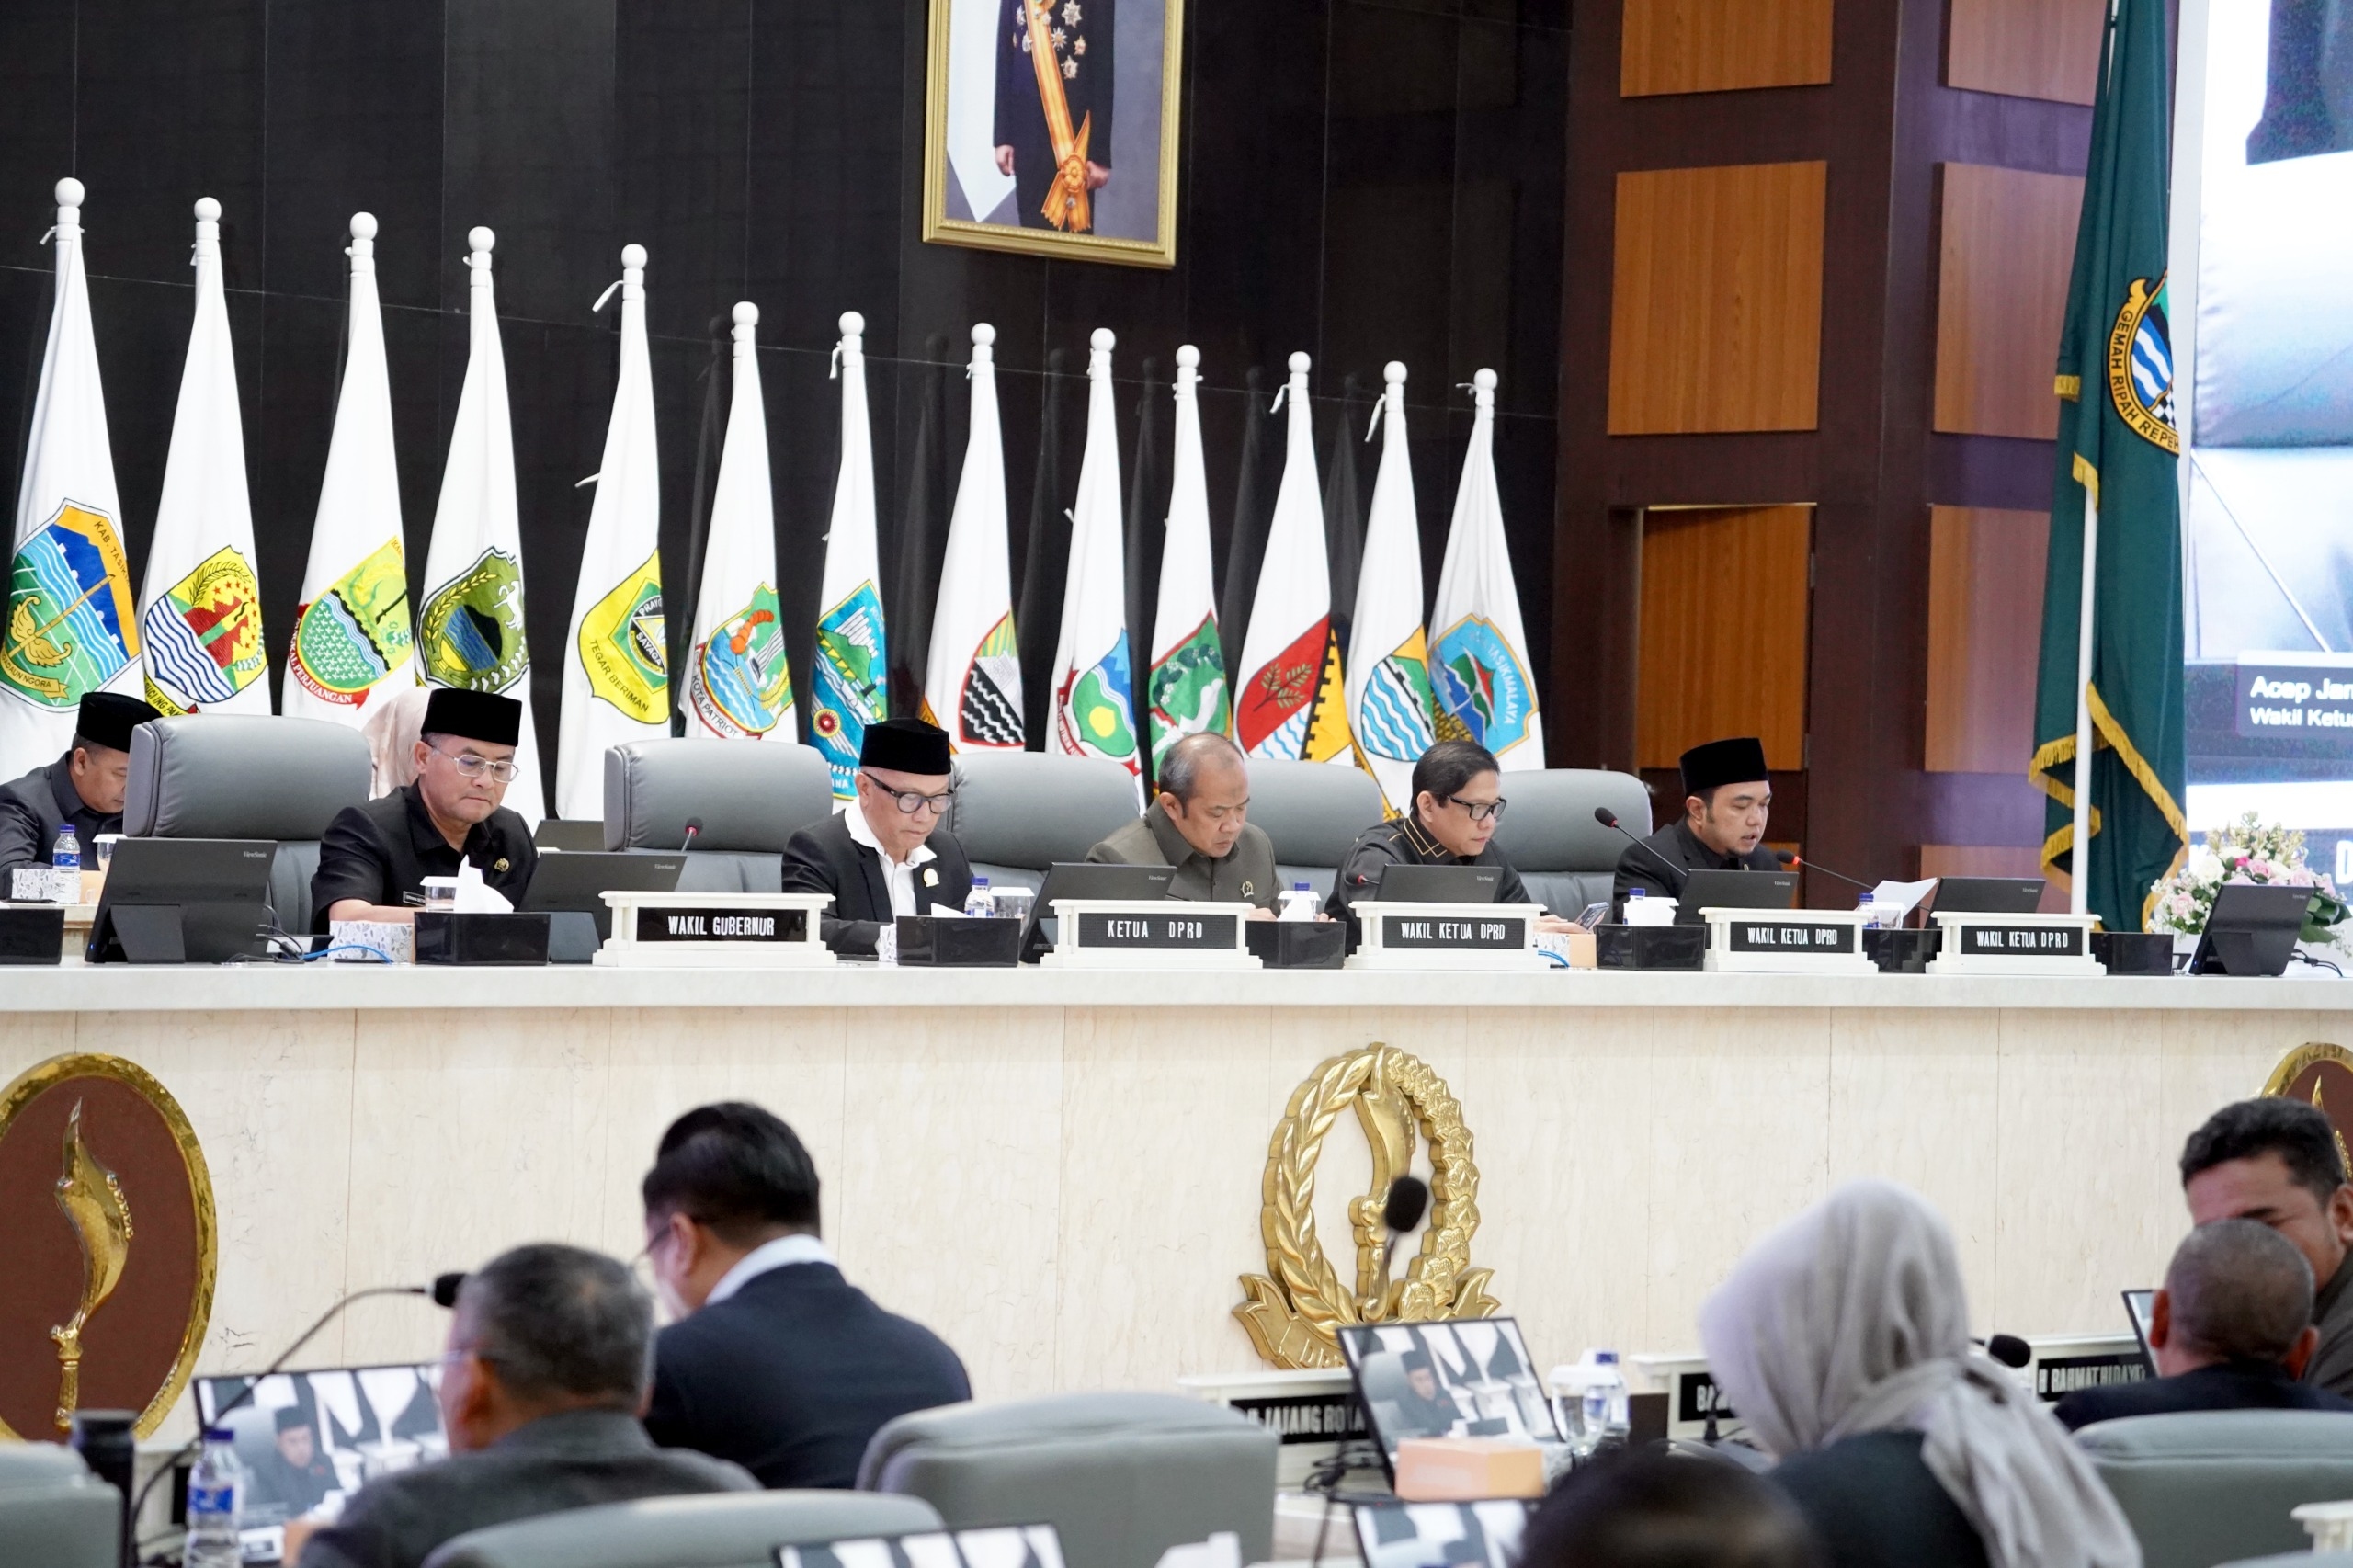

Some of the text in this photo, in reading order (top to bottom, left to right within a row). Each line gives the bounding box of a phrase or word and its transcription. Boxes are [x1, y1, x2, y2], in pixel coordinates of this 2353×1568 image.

[2111, 310, 2133, 369] GEMAH
[2112, 376, 2139, 422] RIPAH
[94, 521, 111, 547] KAB.
[636, 631, 662, 666] SAYAGA
[23, 675, 51, 687] NGORA
[293, 664, 353, 703] PERJUANGAN
[589, 640, 611, 675] TEGAR
[608, 675, 649, 712] BERIMAN
[1488, 645, 1518, 724] TASIKMALAYA
[153, 696, 168, 710] ING
[692, 675, 739, 737] KOTA PATRIOT
[2250, 707, 2302, 726] Wakil
[668, 915, 775, 936] WAKIL GUBERNUR
[1108, 920, 1203, 939] KETUA DPRD
[1401, 922, 1506, 940] WAKIL KETUA DPRD
[1747, 926, 1837, 946] WAKIL KETUA DPRD
[1976, 931, 2068, 949] WAKIL KETUA DPRD
